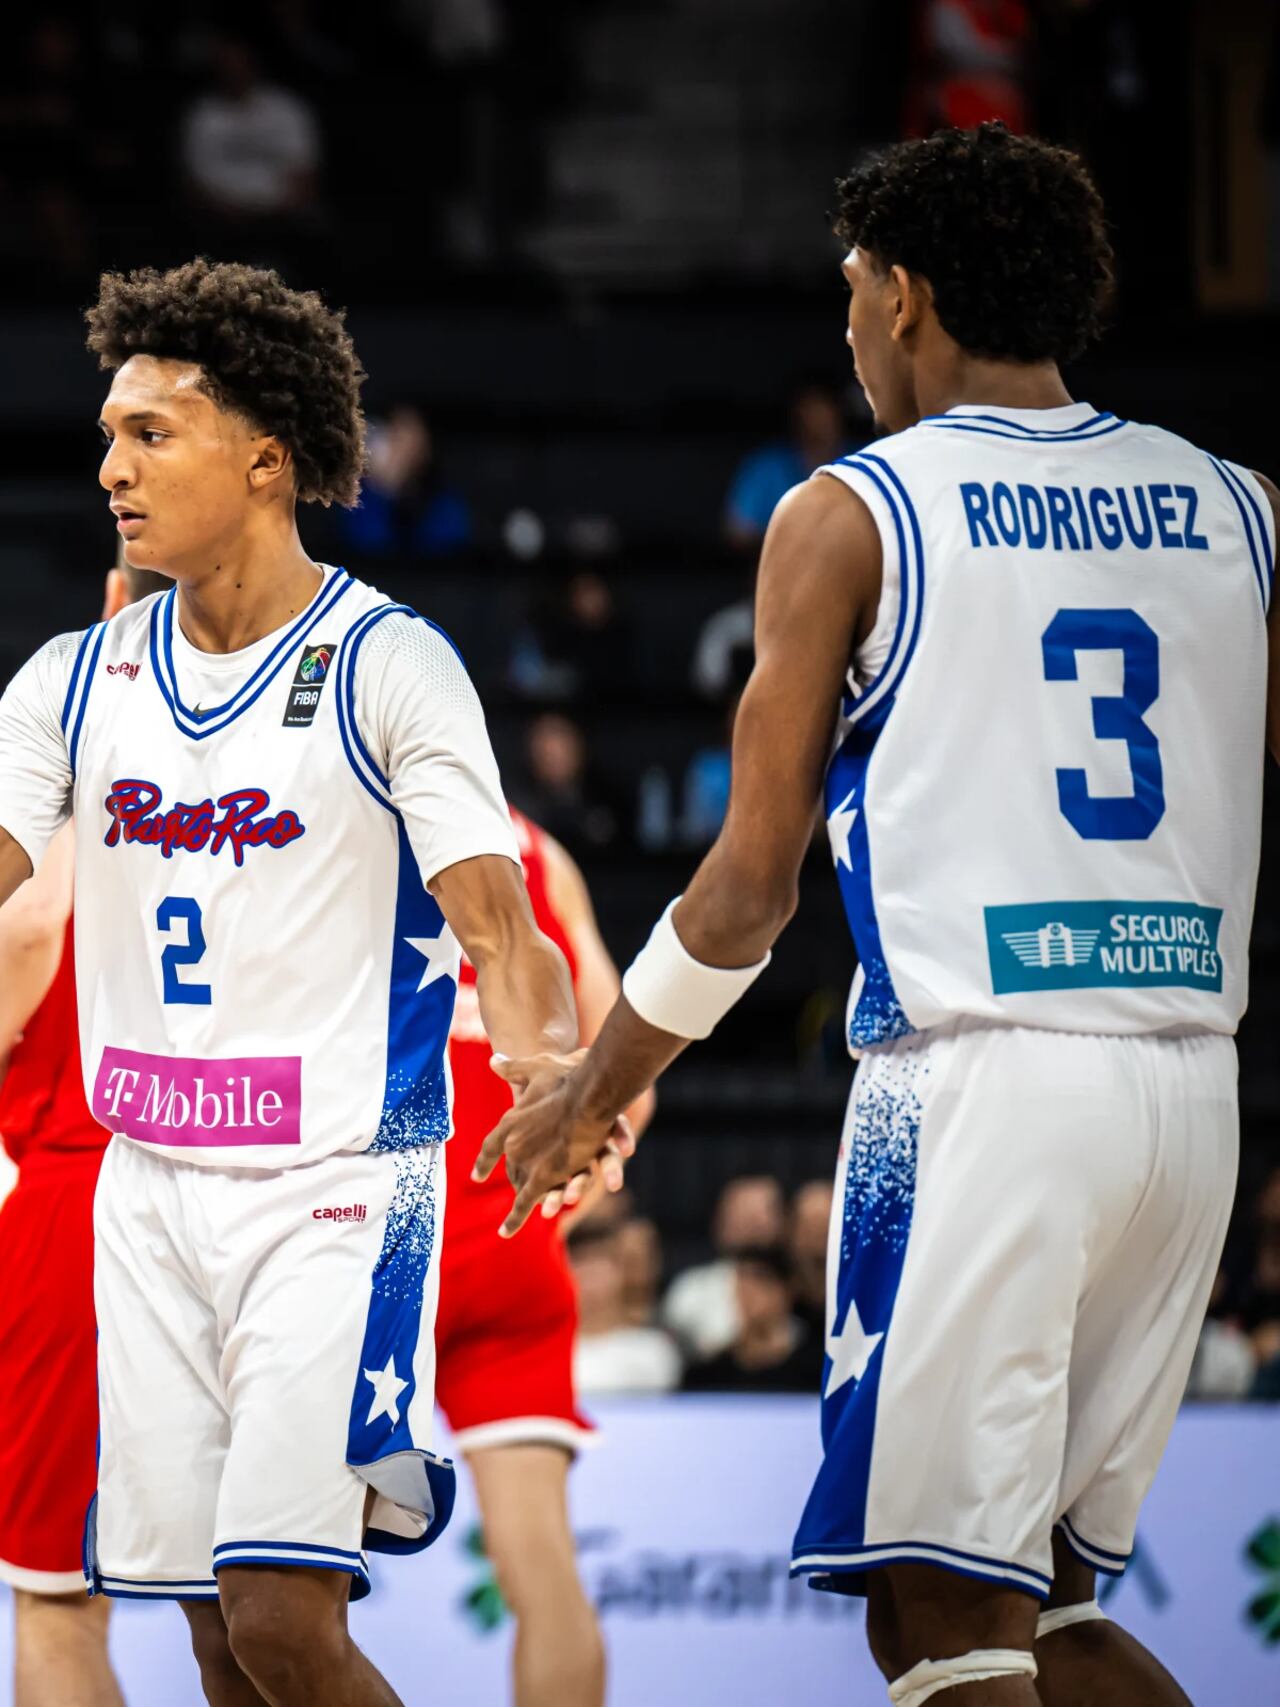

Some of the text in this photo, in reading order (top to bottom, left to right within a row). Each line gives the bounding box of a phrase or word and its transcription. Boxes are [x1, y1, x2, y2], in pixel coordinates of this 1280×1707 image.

[960, 481, 1209, 551] RODRIGUEZ
[293, 690, 319, 706] FIBA
[1041, 608, 1166, 841] 3
[104, 778, 306, 867] Puerto Rico
[157, 896, 212, 1005] 2
[1109, 914, 1210, 946] SEGUROS
[1099, 944, 1218, 978] MULTIPLES
[312, 1203, 368, 1222] capelli
